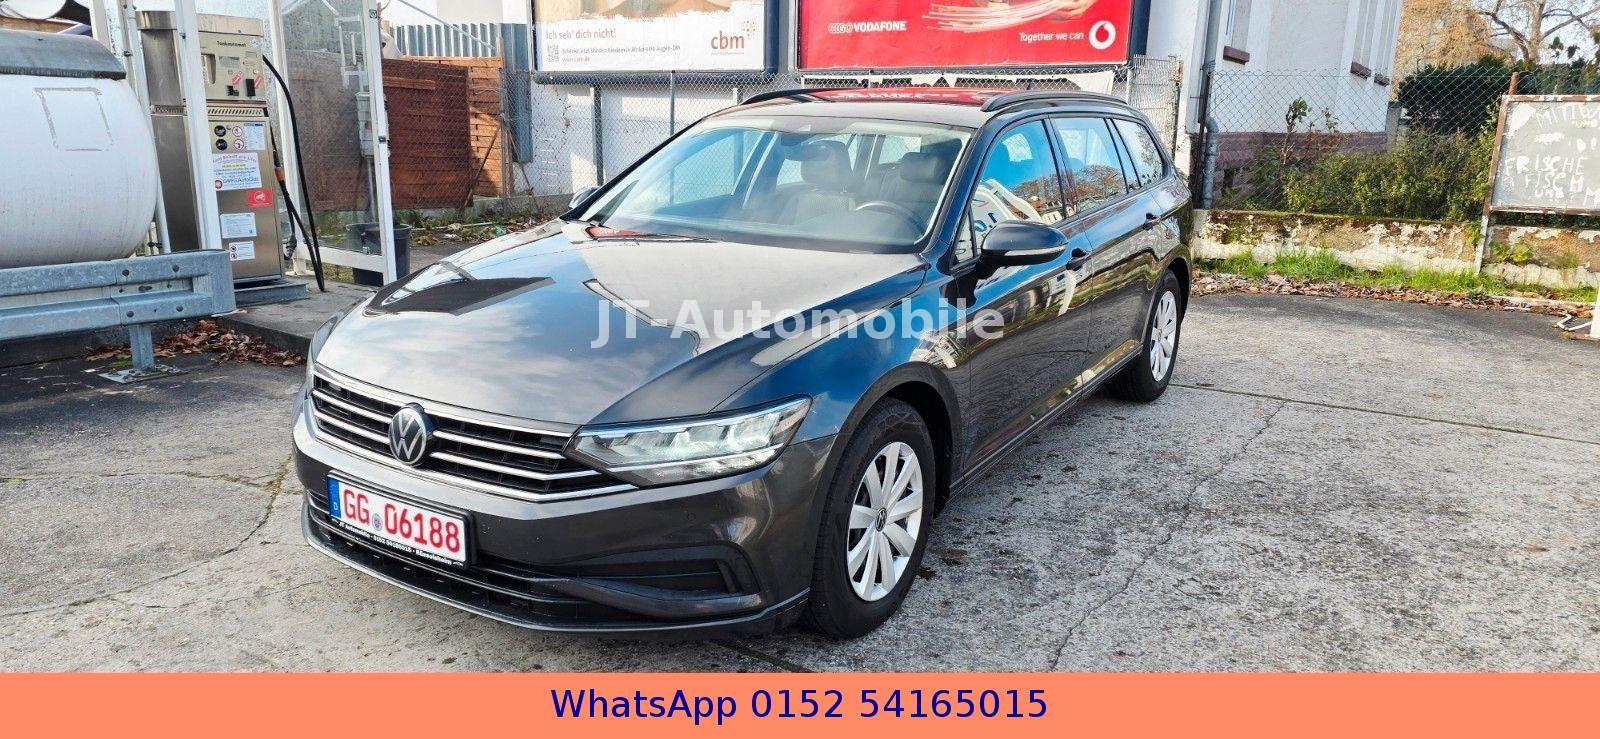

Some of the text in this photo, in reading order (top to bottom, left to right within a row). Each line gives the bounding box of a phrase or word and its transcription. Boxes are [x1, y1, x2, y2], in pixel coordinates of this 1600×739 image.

[546, 30, 558, 40] Ich
[575, 28, 592, 39] dich
[593, 28, 617, 39] nicht!
[711, 30, 745, 50] cbm
[1019, 31, 1085, 43] Together we can
[1505, 154, 1587, 176] FRISCHE
[1524, 170, 1584, 192] FISCH
[343, 488, 460, 553] GG 06188
